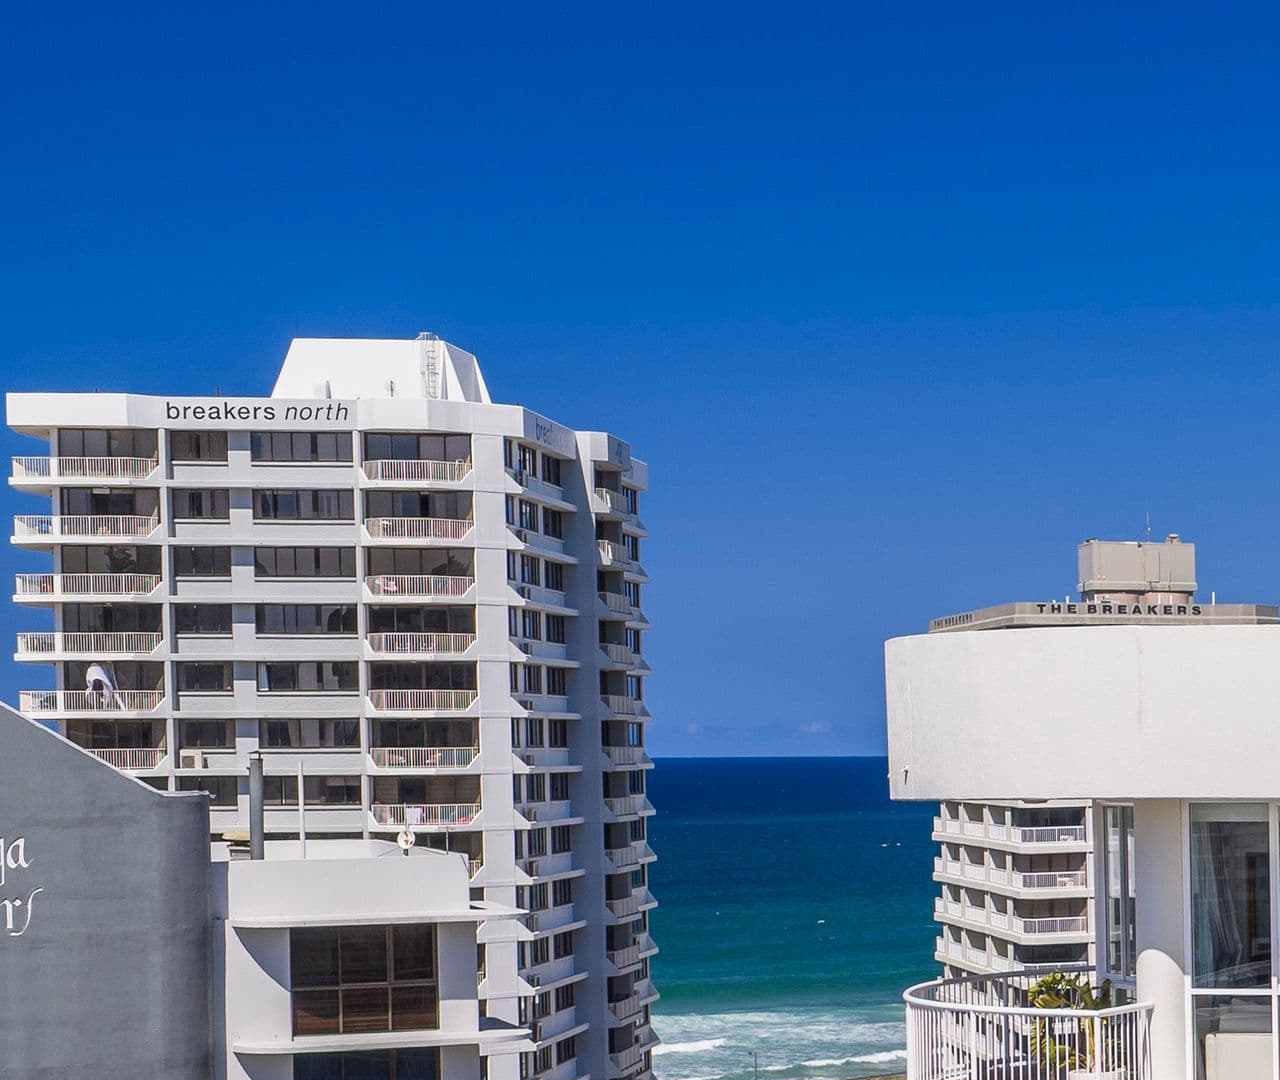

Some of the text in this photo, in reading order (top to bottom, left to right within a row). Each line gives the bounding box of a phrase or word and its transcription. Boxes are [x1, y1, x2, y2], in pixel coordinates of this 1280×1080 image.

[166, 402, 349, 420] breakers north
[1036, 603, 1202, 616] THE BREAKERS
